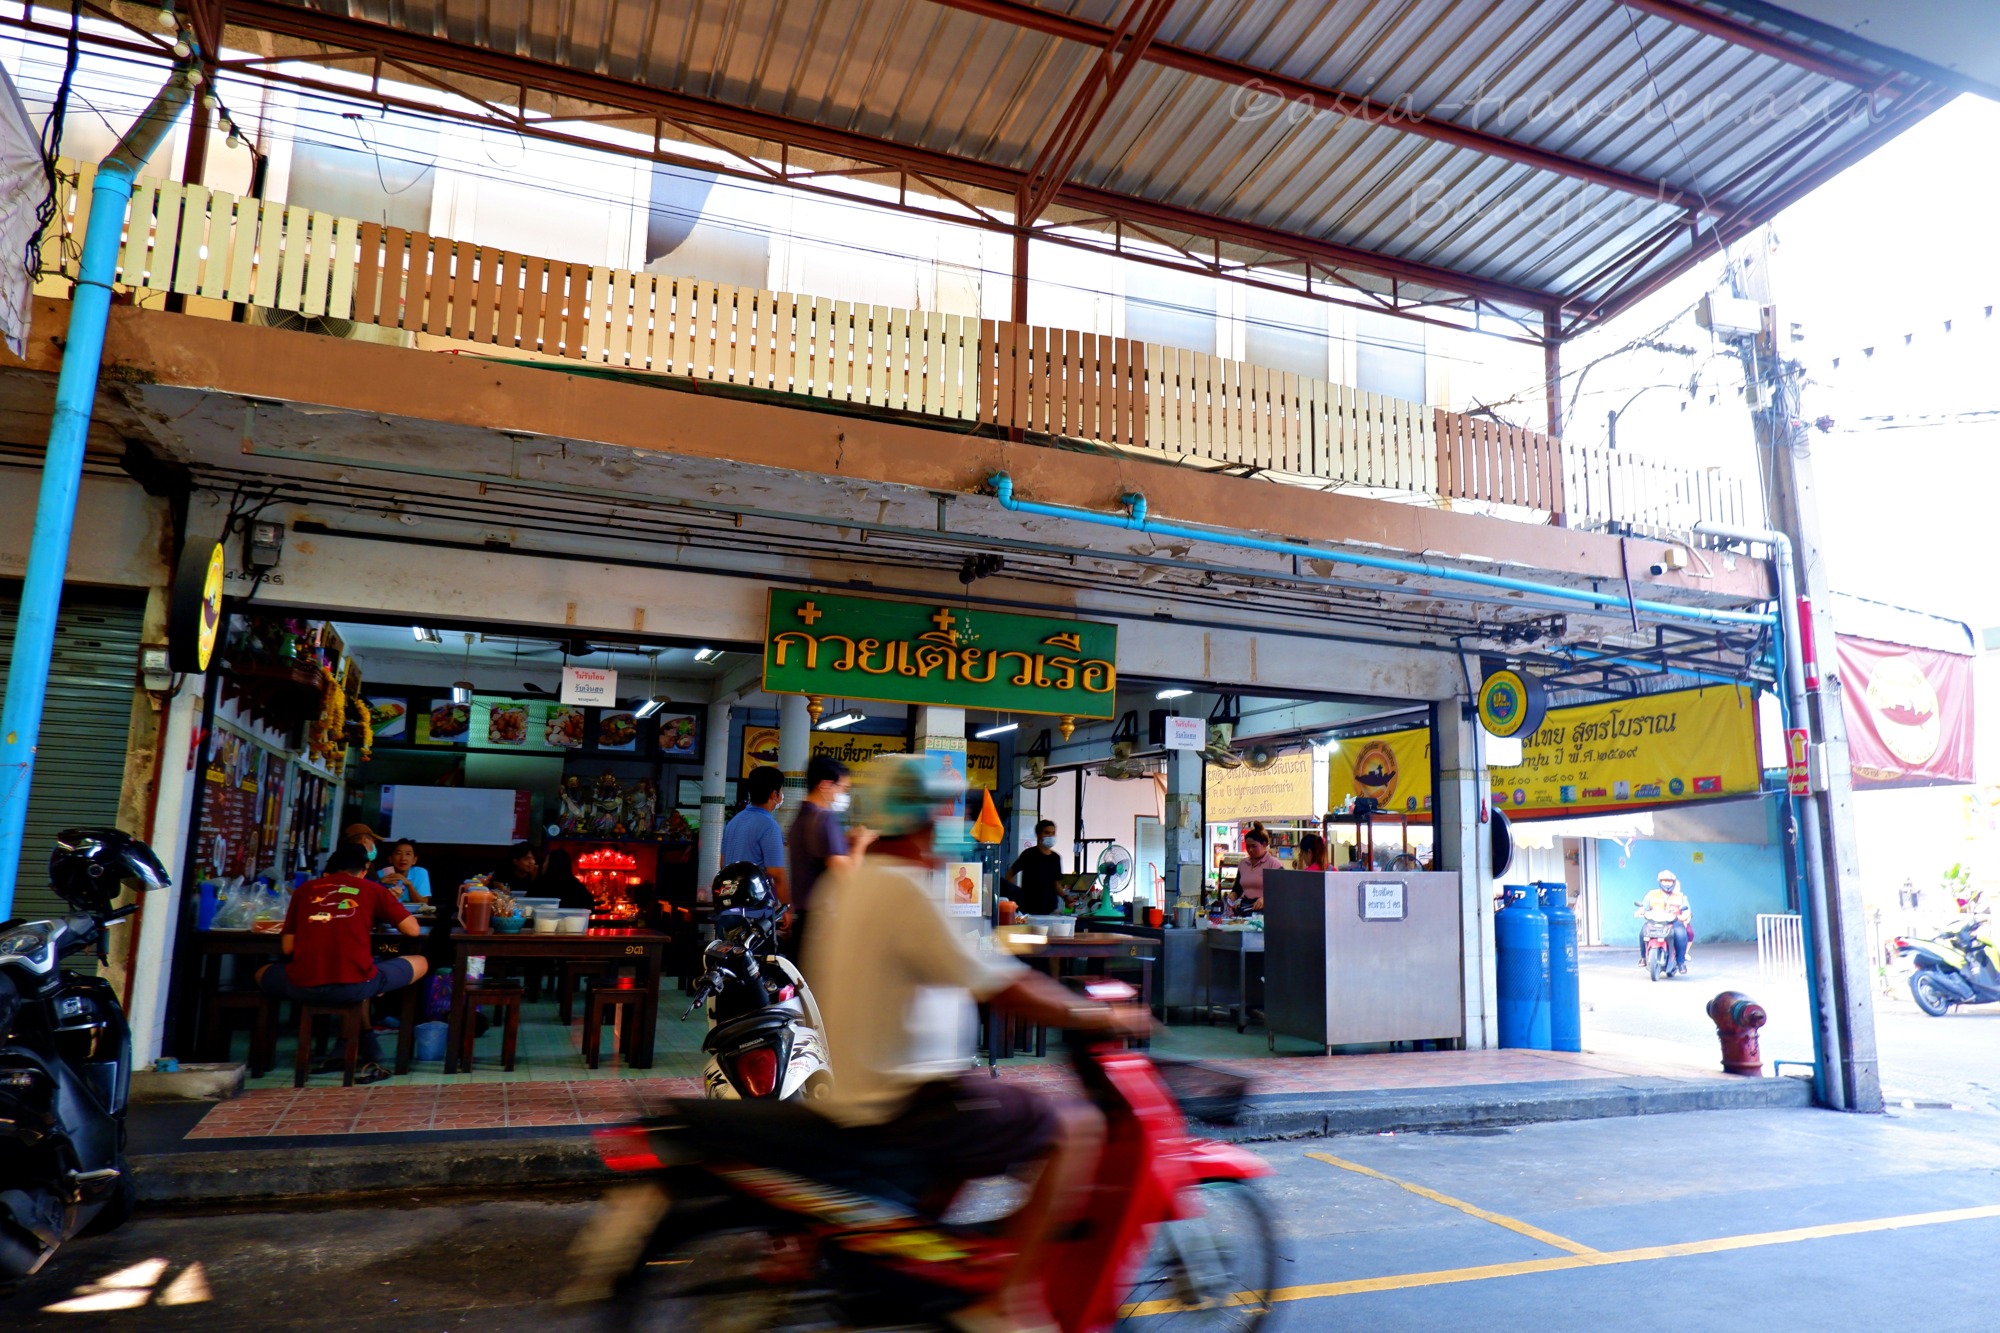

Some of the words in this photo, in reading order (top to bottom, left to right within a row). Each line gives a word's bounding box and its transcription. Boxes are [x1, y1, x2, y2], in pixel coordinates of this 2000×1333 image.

[773, 600, 1115, 694] ก๋วยเตี๋ยวเรือ
[1572, 709, 1677, 750] สูตรโบราณ
[1554, 749, 1564, 765] ปี
[1490, 776, 1504, 787] ปิด
[738, 1037, 765, 1050] HONDA
